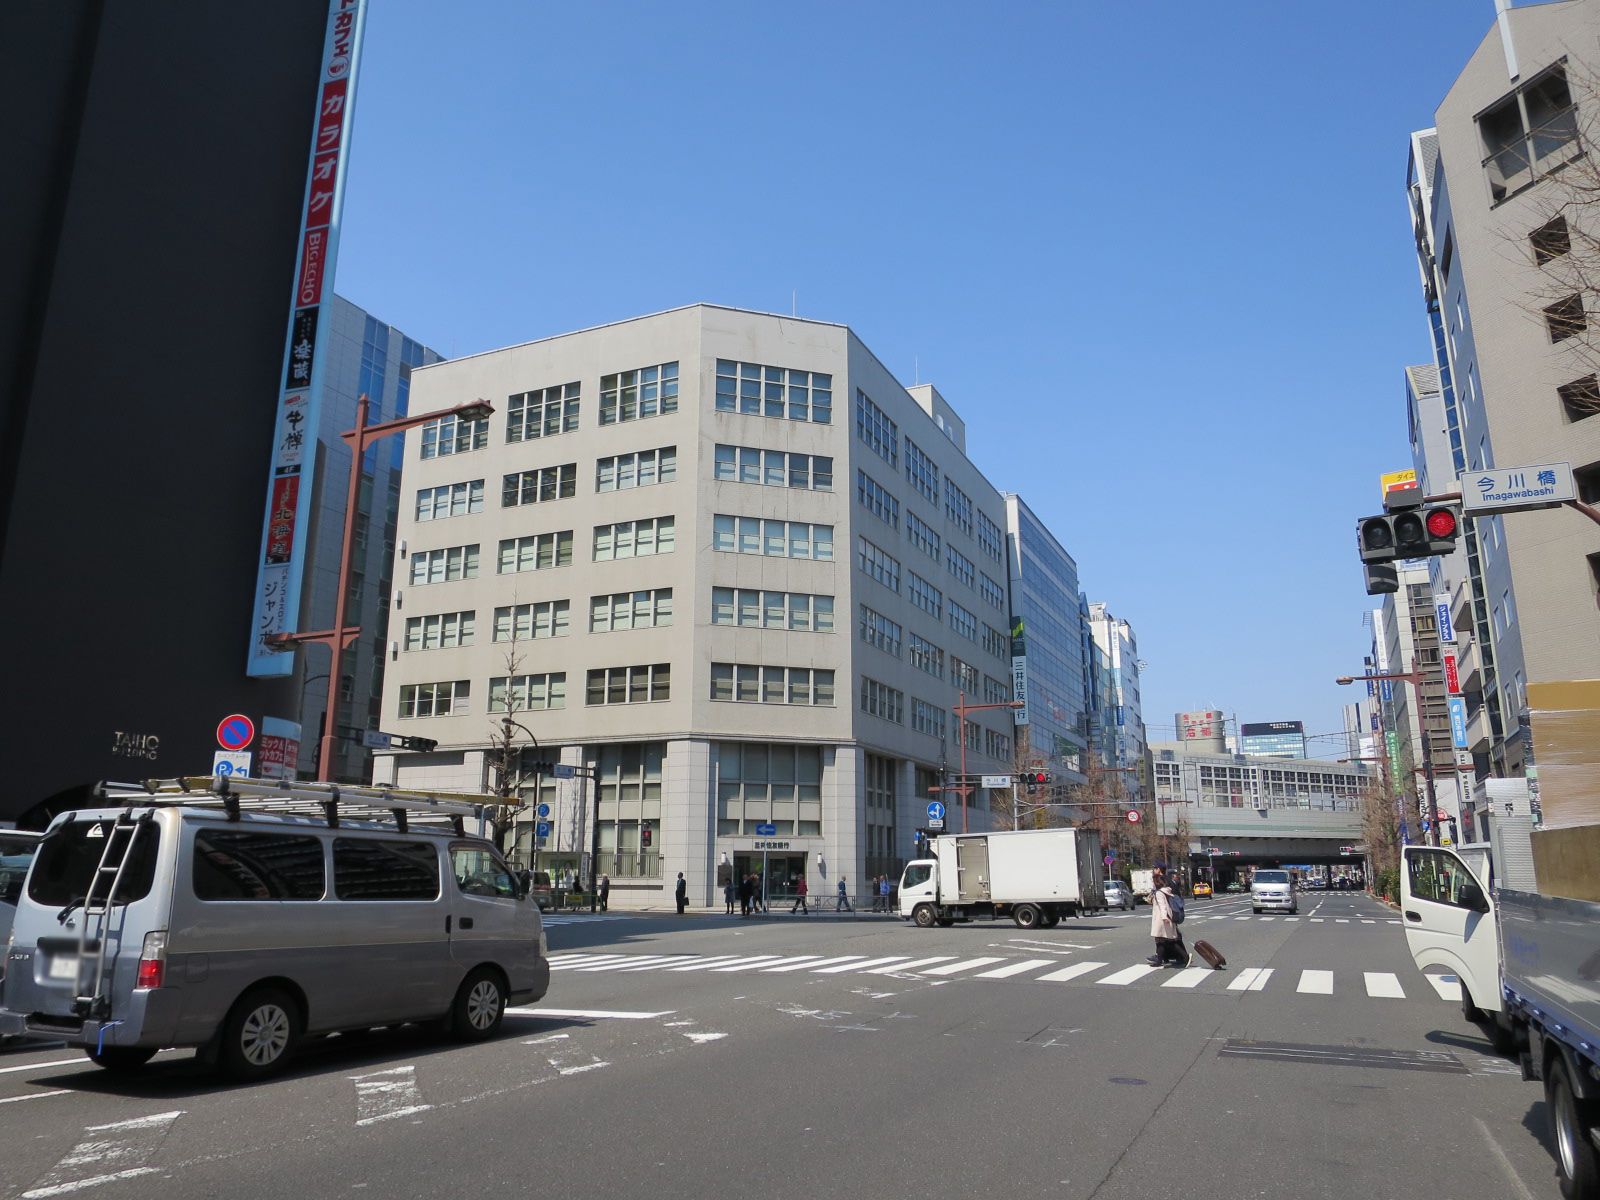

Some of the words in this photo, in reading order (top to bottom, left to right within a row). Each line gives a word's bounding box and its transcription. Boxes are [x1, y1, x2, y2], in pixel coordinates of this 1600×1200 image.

[310, 94, 344, 212] カラオケ
[308, 233, 322, 261] BIG
[302, 262, 317, 304] ECHO
[1477, 469, 1556, 492] 今川橋
[1483, 486, 1554, 501] Imagawabashi
[1015, 661, 1026, 719] 三井住友行
[1462, 782, 1470, 799] SUITS
